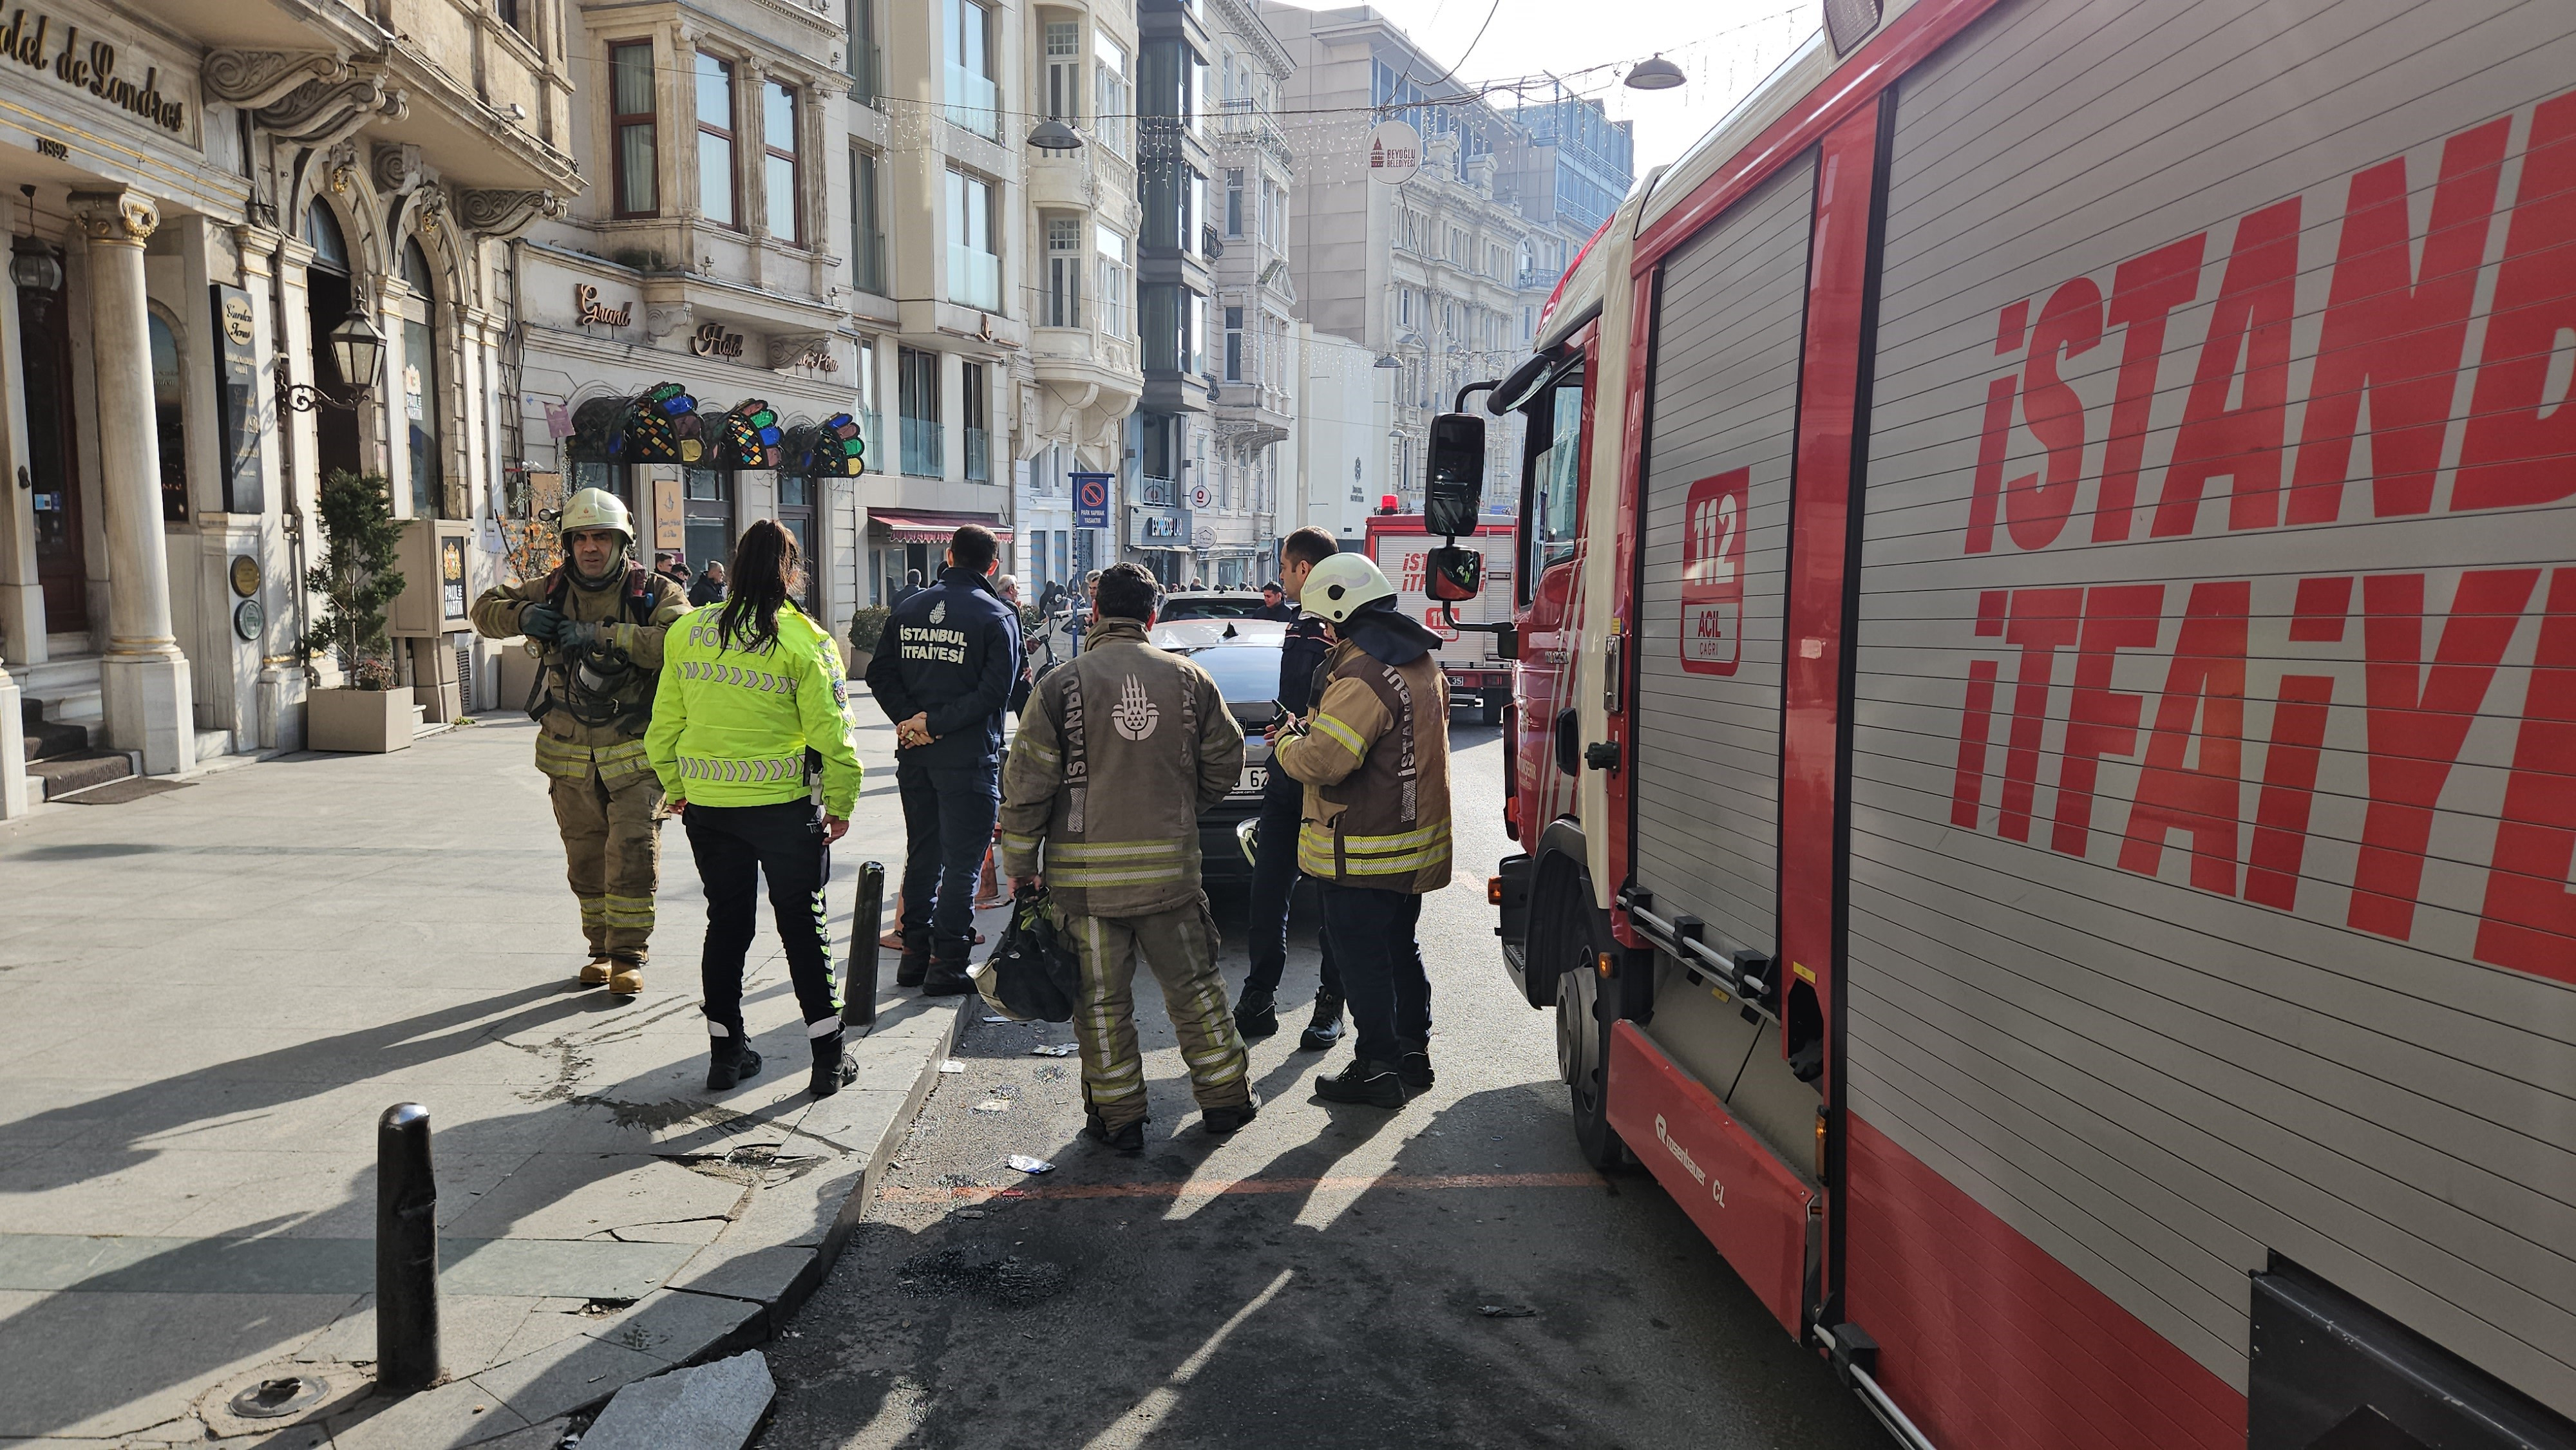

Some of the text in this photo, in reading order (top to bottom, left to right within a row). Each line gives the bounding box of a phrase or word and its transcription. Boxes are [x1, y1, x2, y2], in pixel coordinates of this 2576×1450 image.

[0, 8, 184, 132] otel de Londres
[37, 138, 69, 161] 1892
[1387, 147, 1416, 159] BEYOĞLU
[575, 283, 632, 326] Grand
[688, 323, 743, 357] Hotel
[1694, 494, 1737, 587] 112
[444, 585, 459, 600] PAUL
[446, 599, 463, 616] MARTIN
[900, 624, 967, 647] İSTANBUL
[902, 642, 964, 664] İTFAİYESİ
[1700, 641, 1718, 659] ÇAĞRI
[1713, 1180, 1725, 1209] CL
